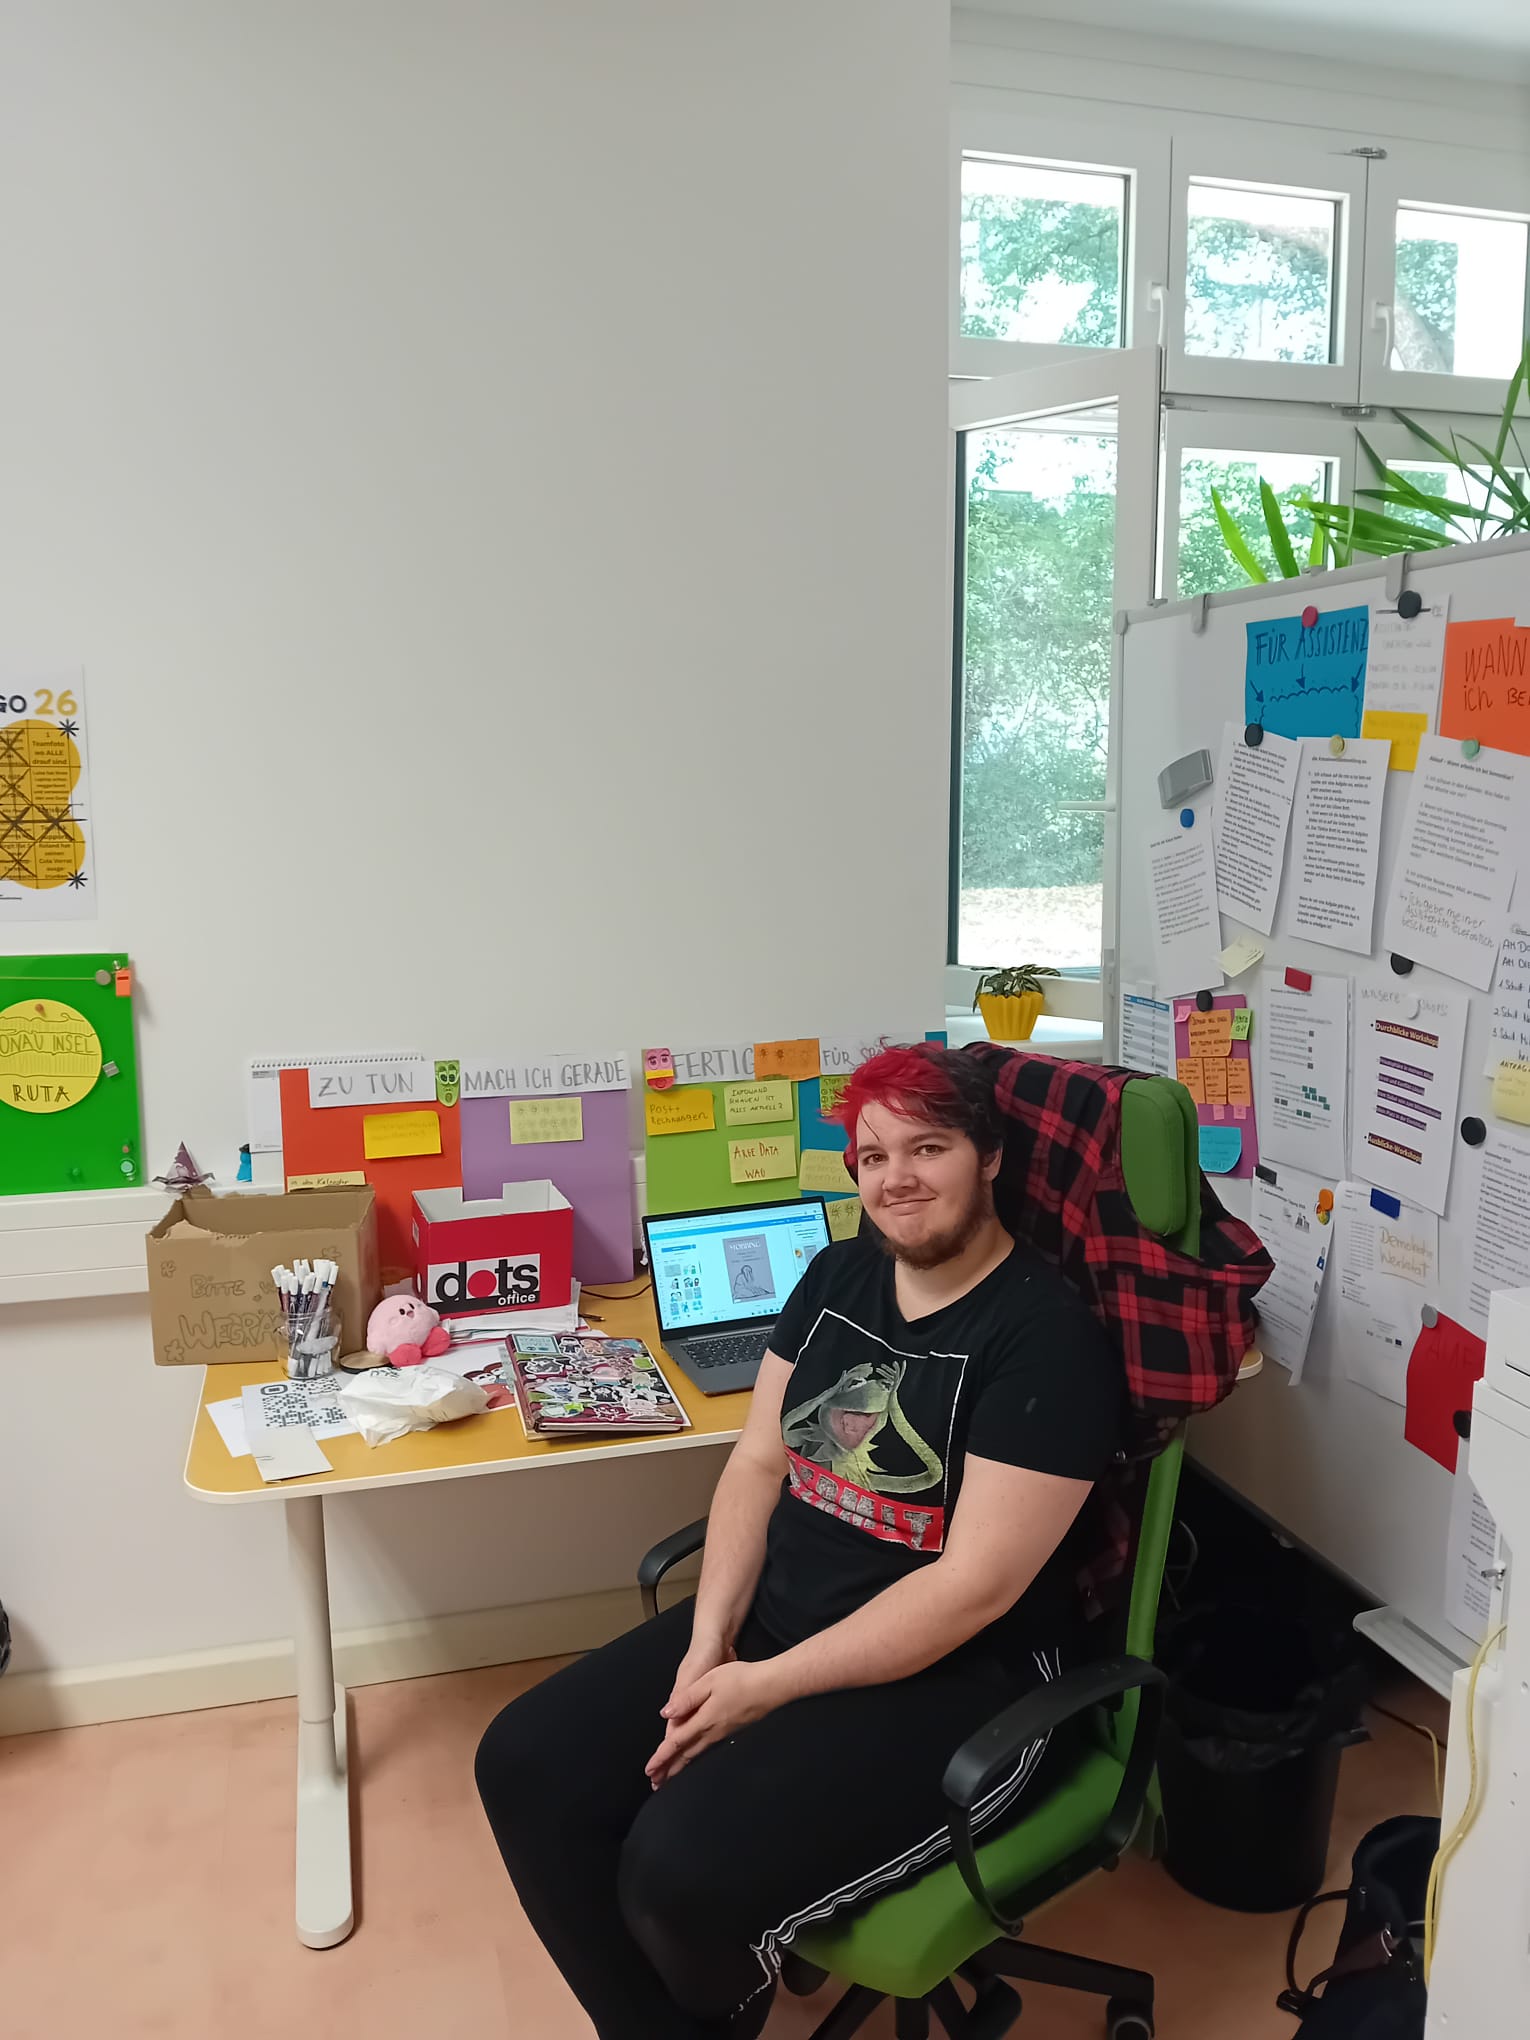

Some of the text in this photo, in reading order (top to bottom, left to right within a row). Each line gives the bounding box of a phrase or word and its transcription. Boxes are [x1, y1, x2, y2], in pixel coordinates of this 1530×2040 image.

[1256, 618, 1370, 665] FÜR ASSISTENZ
[1464, 634, 1528, 684] WANN
[33, 688, 77, 716] 26
[53, 1034, 92, 1053] INSEL
[823, 1047, 855, 1066] FÜR
[318, 1071, 414, 1097] ZU TUN
[465, 1059, 627, 1091] MACH ICH GERADE
[12, 1084, 70, 1103] RUTA
[498, 1293, 536, 1306] office
